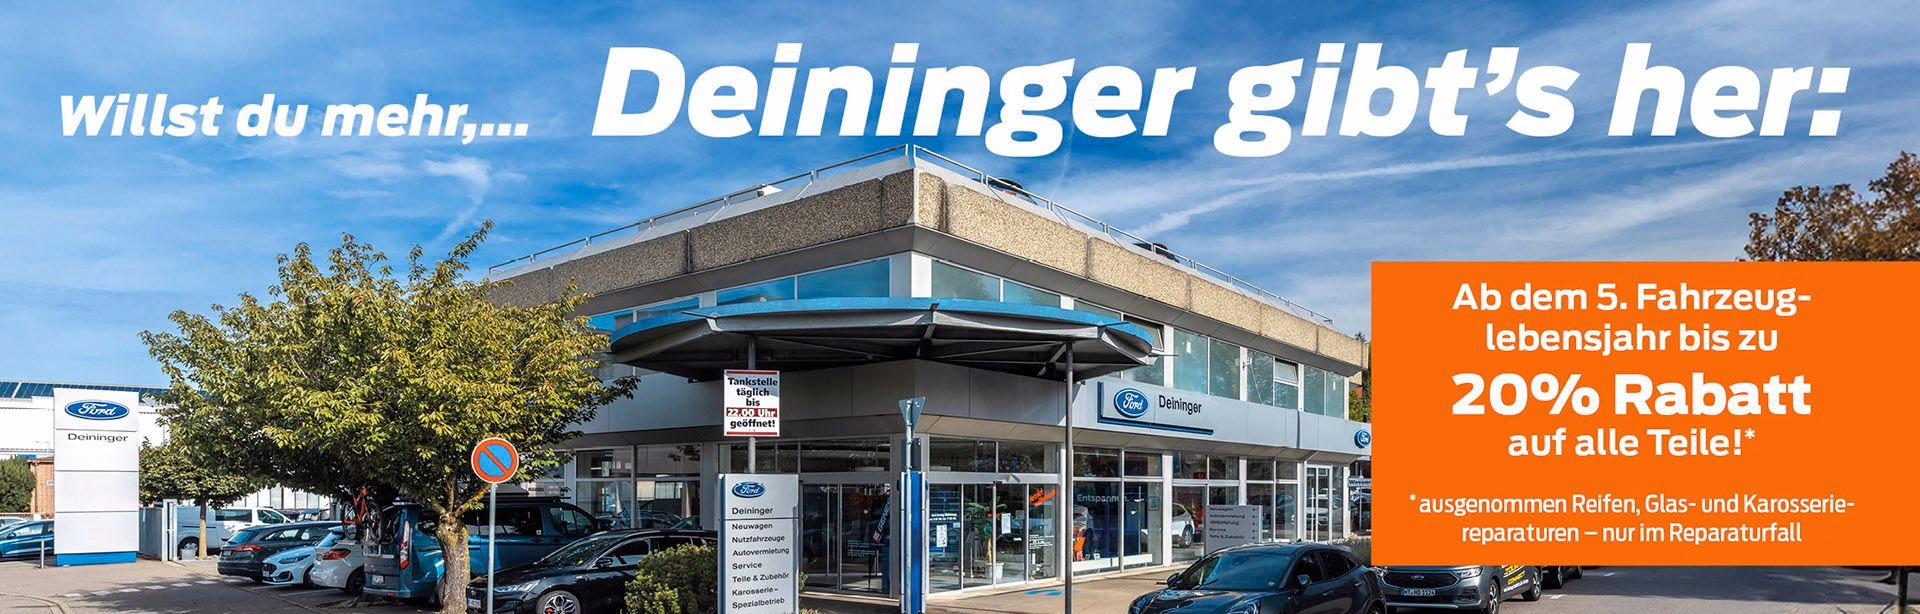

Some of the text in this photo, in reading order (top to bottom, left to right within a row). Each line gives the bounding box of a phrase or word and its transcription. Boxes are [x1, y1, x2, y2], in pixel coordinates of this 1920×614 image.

[727, 377, 778, 386] Tankstelle
[736, 387, 770, 398] täglich
[746, 398, 760, 407] bis
[1122, 392, 1144, 410] Ford
[1158, 394, 1202, 416] Deininger
[78, 402, 116, 416] Ford
[727, 408, 776, 418] 22.00 Uhr
[730, 418, 775, 430] geöffnet!
[67, 433, 129, 443] Deininger
[740, 485, 760, 494] Ford
[731, 507, 773, 516] Deininger
[731, 523, 773, 532] Neuwagen
[731, 535, 785, 544] Nutzfahrzeuge
[732, 548, 790, 557] Autovermietung
[732, 562, 763, 570] Service
[760, 572, 789, 581] Zubehör
[731, 588, 779, 597] Karosserie-
[731, 598, 785, 610] Spezialbetrieb
